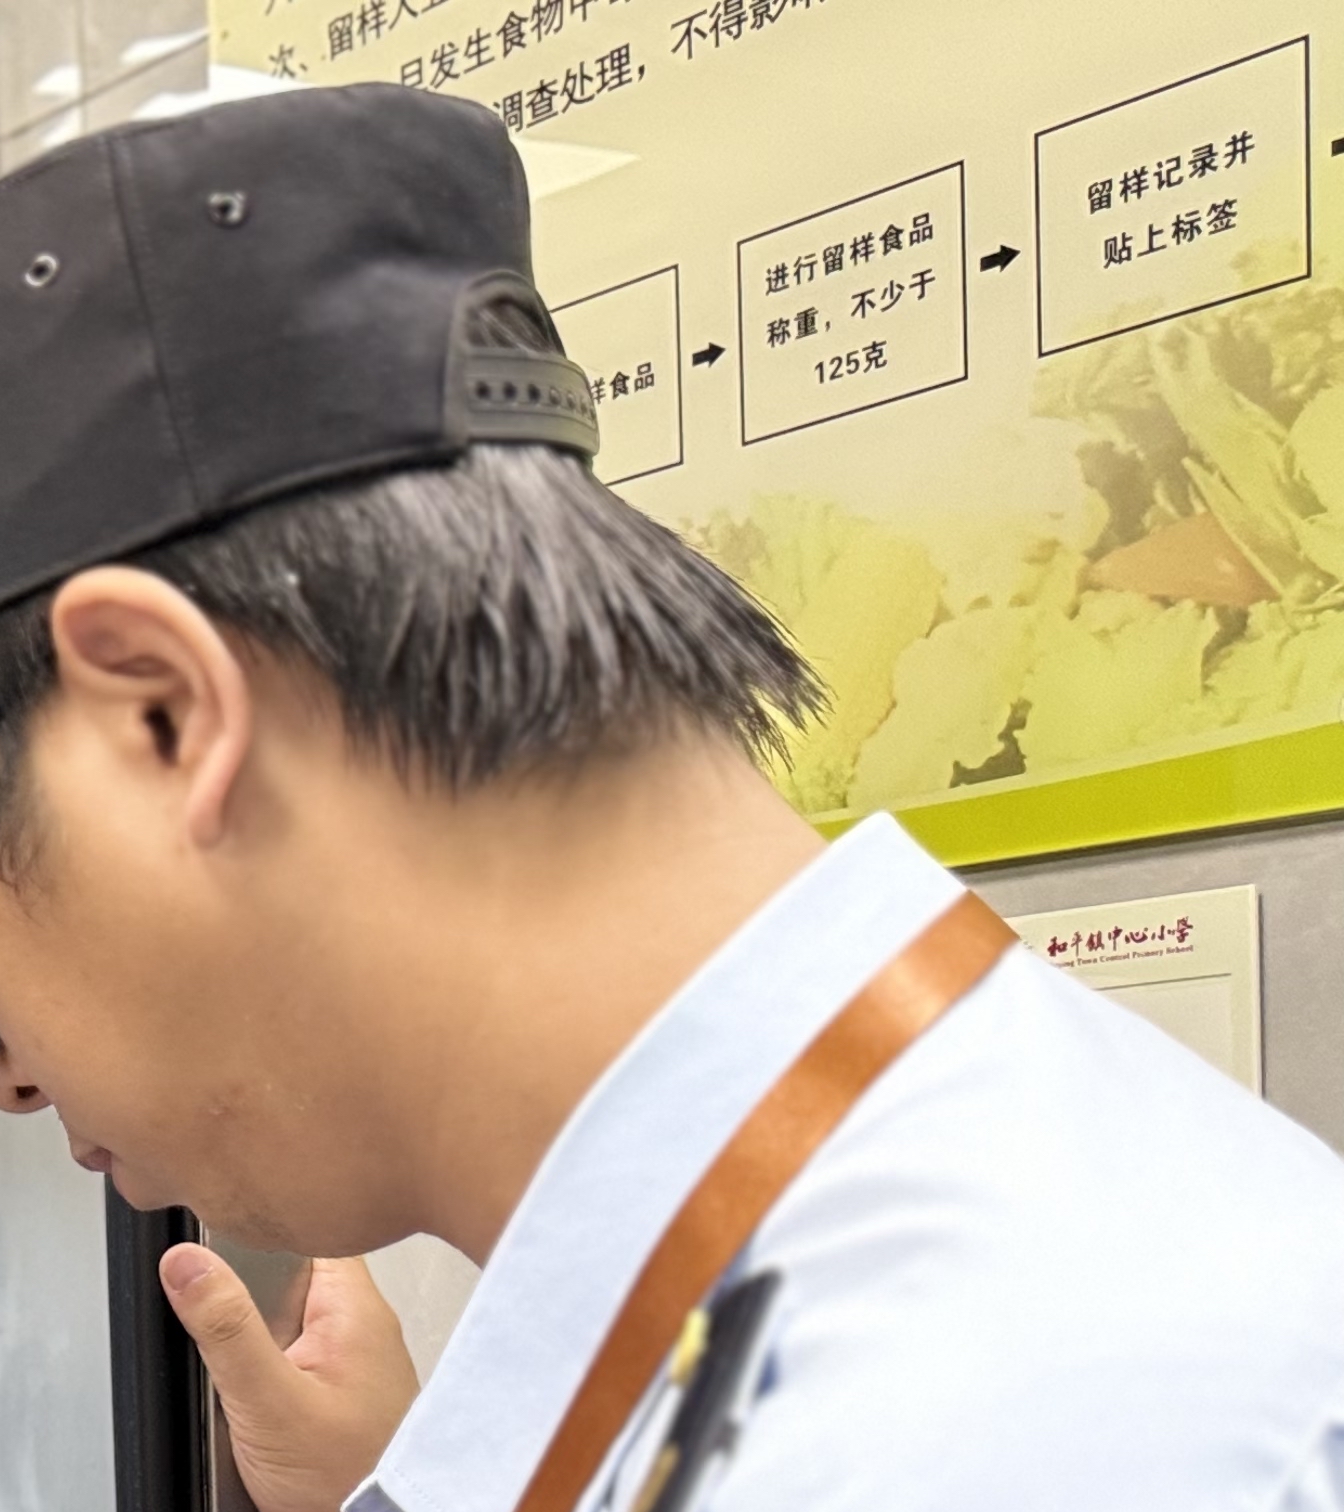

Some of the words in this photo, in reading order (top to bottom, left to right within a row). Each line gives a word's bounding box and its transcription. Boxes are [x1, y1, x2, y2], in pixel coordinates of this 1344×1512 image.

[400, 0, 632, 90] 旦发生食物
[1087, 130, 1255, 215] 留样记录并
[765, 213, 934, 295] 进行留样食品
[1103, 198, 1238, 269] 贴上标签
[814, 340, 888, 384] 125克
